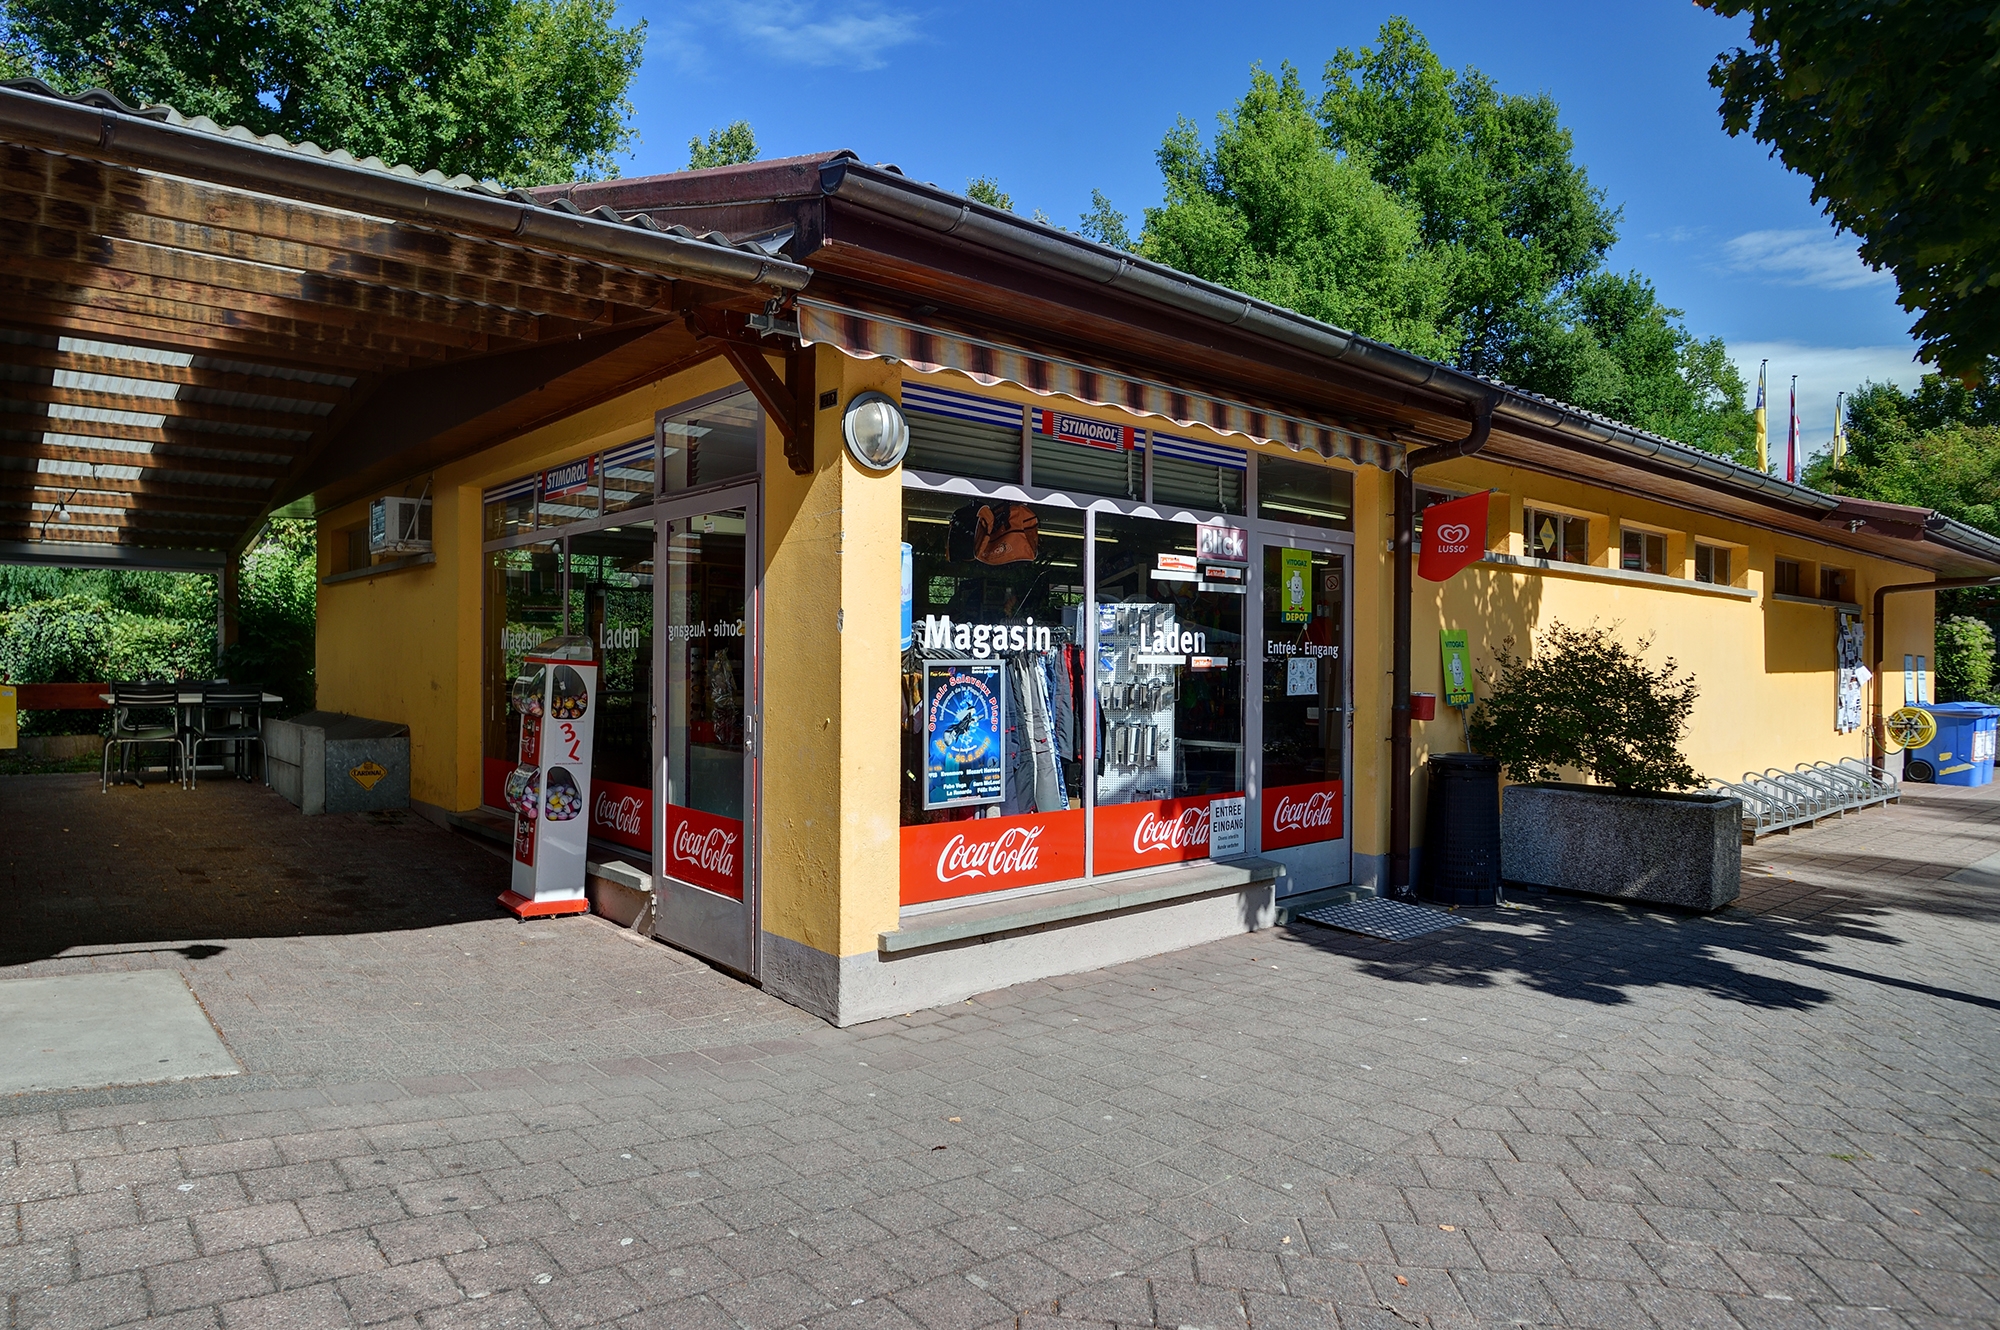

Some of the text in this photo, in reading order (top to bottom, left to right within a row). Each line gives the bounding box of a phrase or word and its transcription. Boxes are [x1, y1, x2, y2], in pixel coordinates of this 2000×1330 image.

[1061, 419, 1116, 441] STIMOROL
[547, 463, 587, 490] STIMOROL
[1202, 528, 1243, 556] Blick
[1438, 545, 1466, 553] LUSSO
[1286, 558, 1307, 567] VITOGAZ
[1285, 612, 1308, 622] DEPOT
[501, 626, 542, 655] Magasin
[600, 621, 639, 649] Laden
[924, 614, 1051, 659] Magasin
[1140, 622, 1206, 653] Laden
[1445, 640, 1465, 648] VITOGAZ
[1267, 640, 1297, 655] Entrée
[1304, 641, 1339, 659] Eingang
[928, 684, 948, 731] Openair
[949, 674, 991, 697] Salavaux
[989, 697, 999, 732] Plage
[1450, 694, 1471, 704] DEPOT
[594, 791, 644, 835] Coca-Cola
[1215, 802, 1241, 818] ENTRÉE
[1273, 791, 1336, 832] Coca-Cola
[1133, 807, 1210, 854] Coca-Cola
[1213, 818, 1243, 832] EINGANG
[673, 819, 738, 877] Coca-Cola
[936, 825, 1046, 883] Coca-Cola
